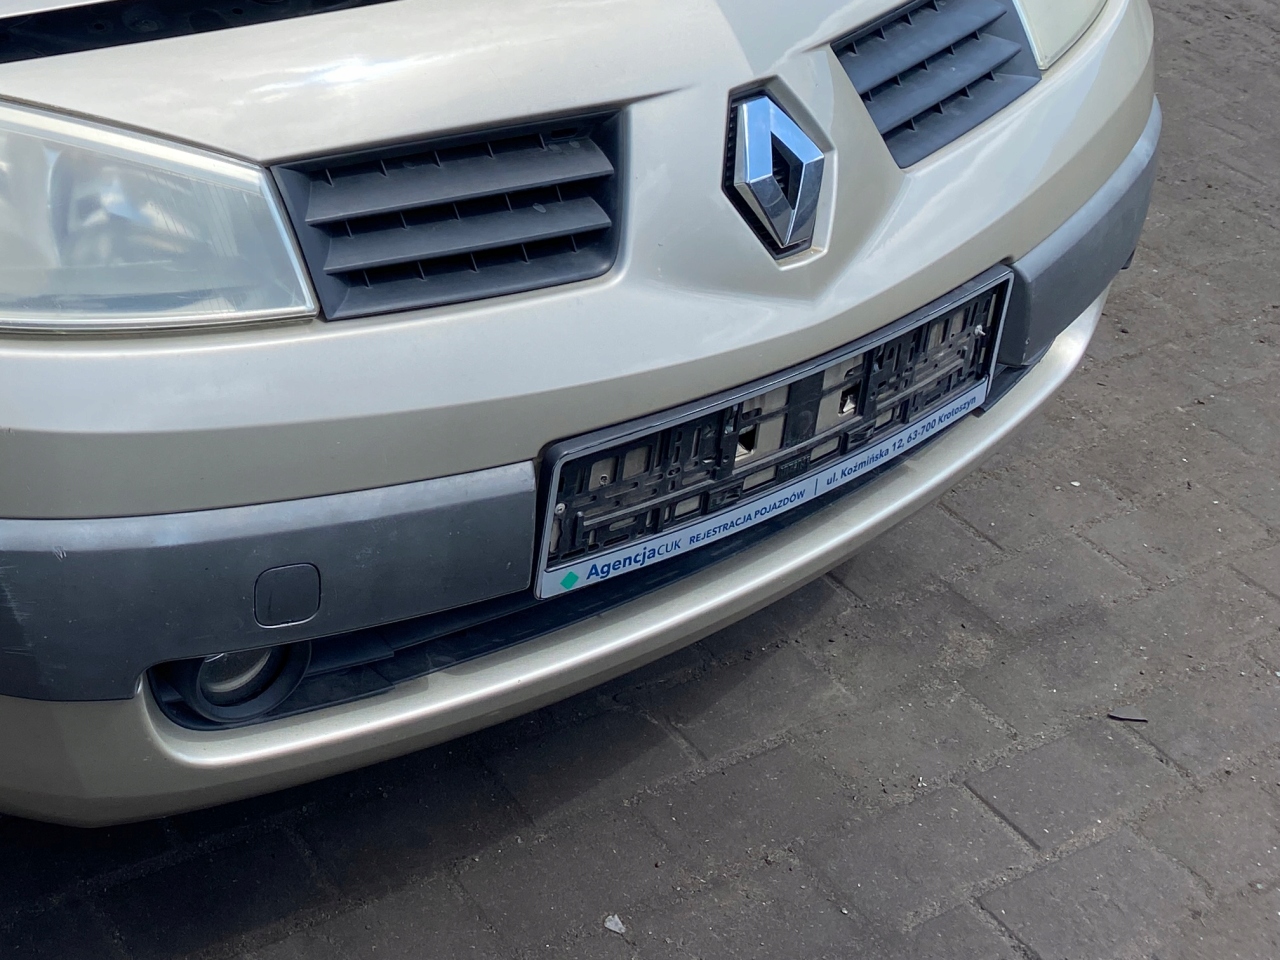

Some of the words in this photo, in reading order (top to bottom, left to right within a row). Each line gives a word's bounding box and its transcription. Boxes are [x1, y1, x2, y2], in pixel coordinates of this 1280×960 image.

[688, 513, 753, 545] REJESTRACJA
[753, 489, 806, 519] POJAZDÓW
[826, 471, 839, 486] ul.
[840, 448, 890, 479] Koźmińska
[891, 438, 905, 452] 12,
[906, 418, 937, 444] 63-700
[937, 396, 977, 426] Krotoszyn
